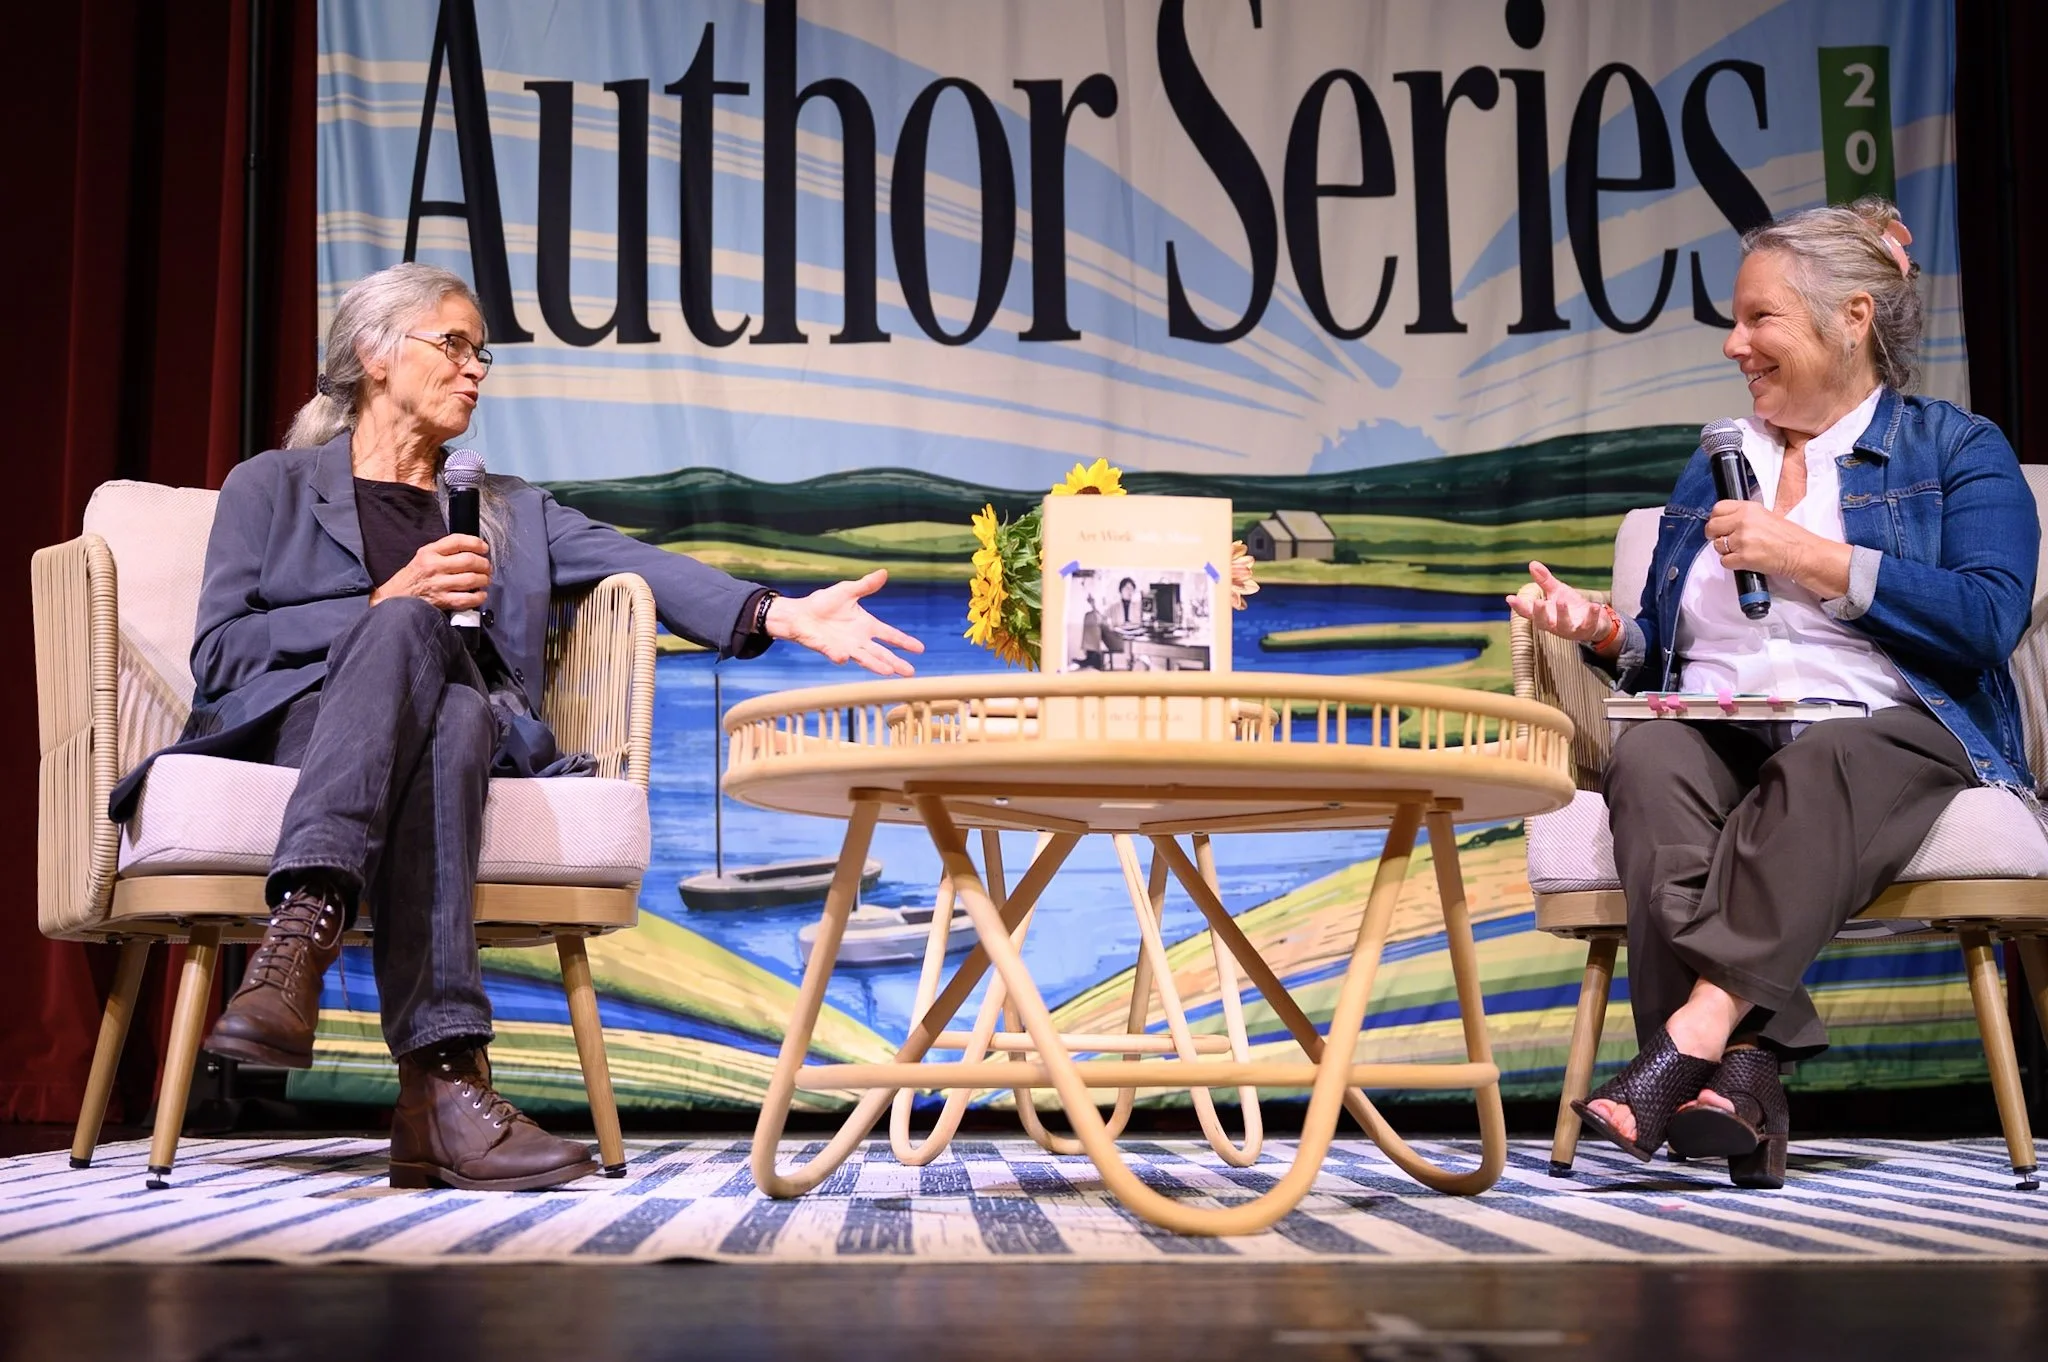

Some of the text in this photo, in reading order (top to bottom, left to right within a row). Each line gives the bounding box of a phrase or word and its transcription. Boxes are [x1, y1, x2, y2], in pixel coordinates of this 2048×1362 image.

[403, 0, 1776, 347] Author Series
[1077, 529, 1097, 542] Art
[1100, 529, 1134, 542] Work
